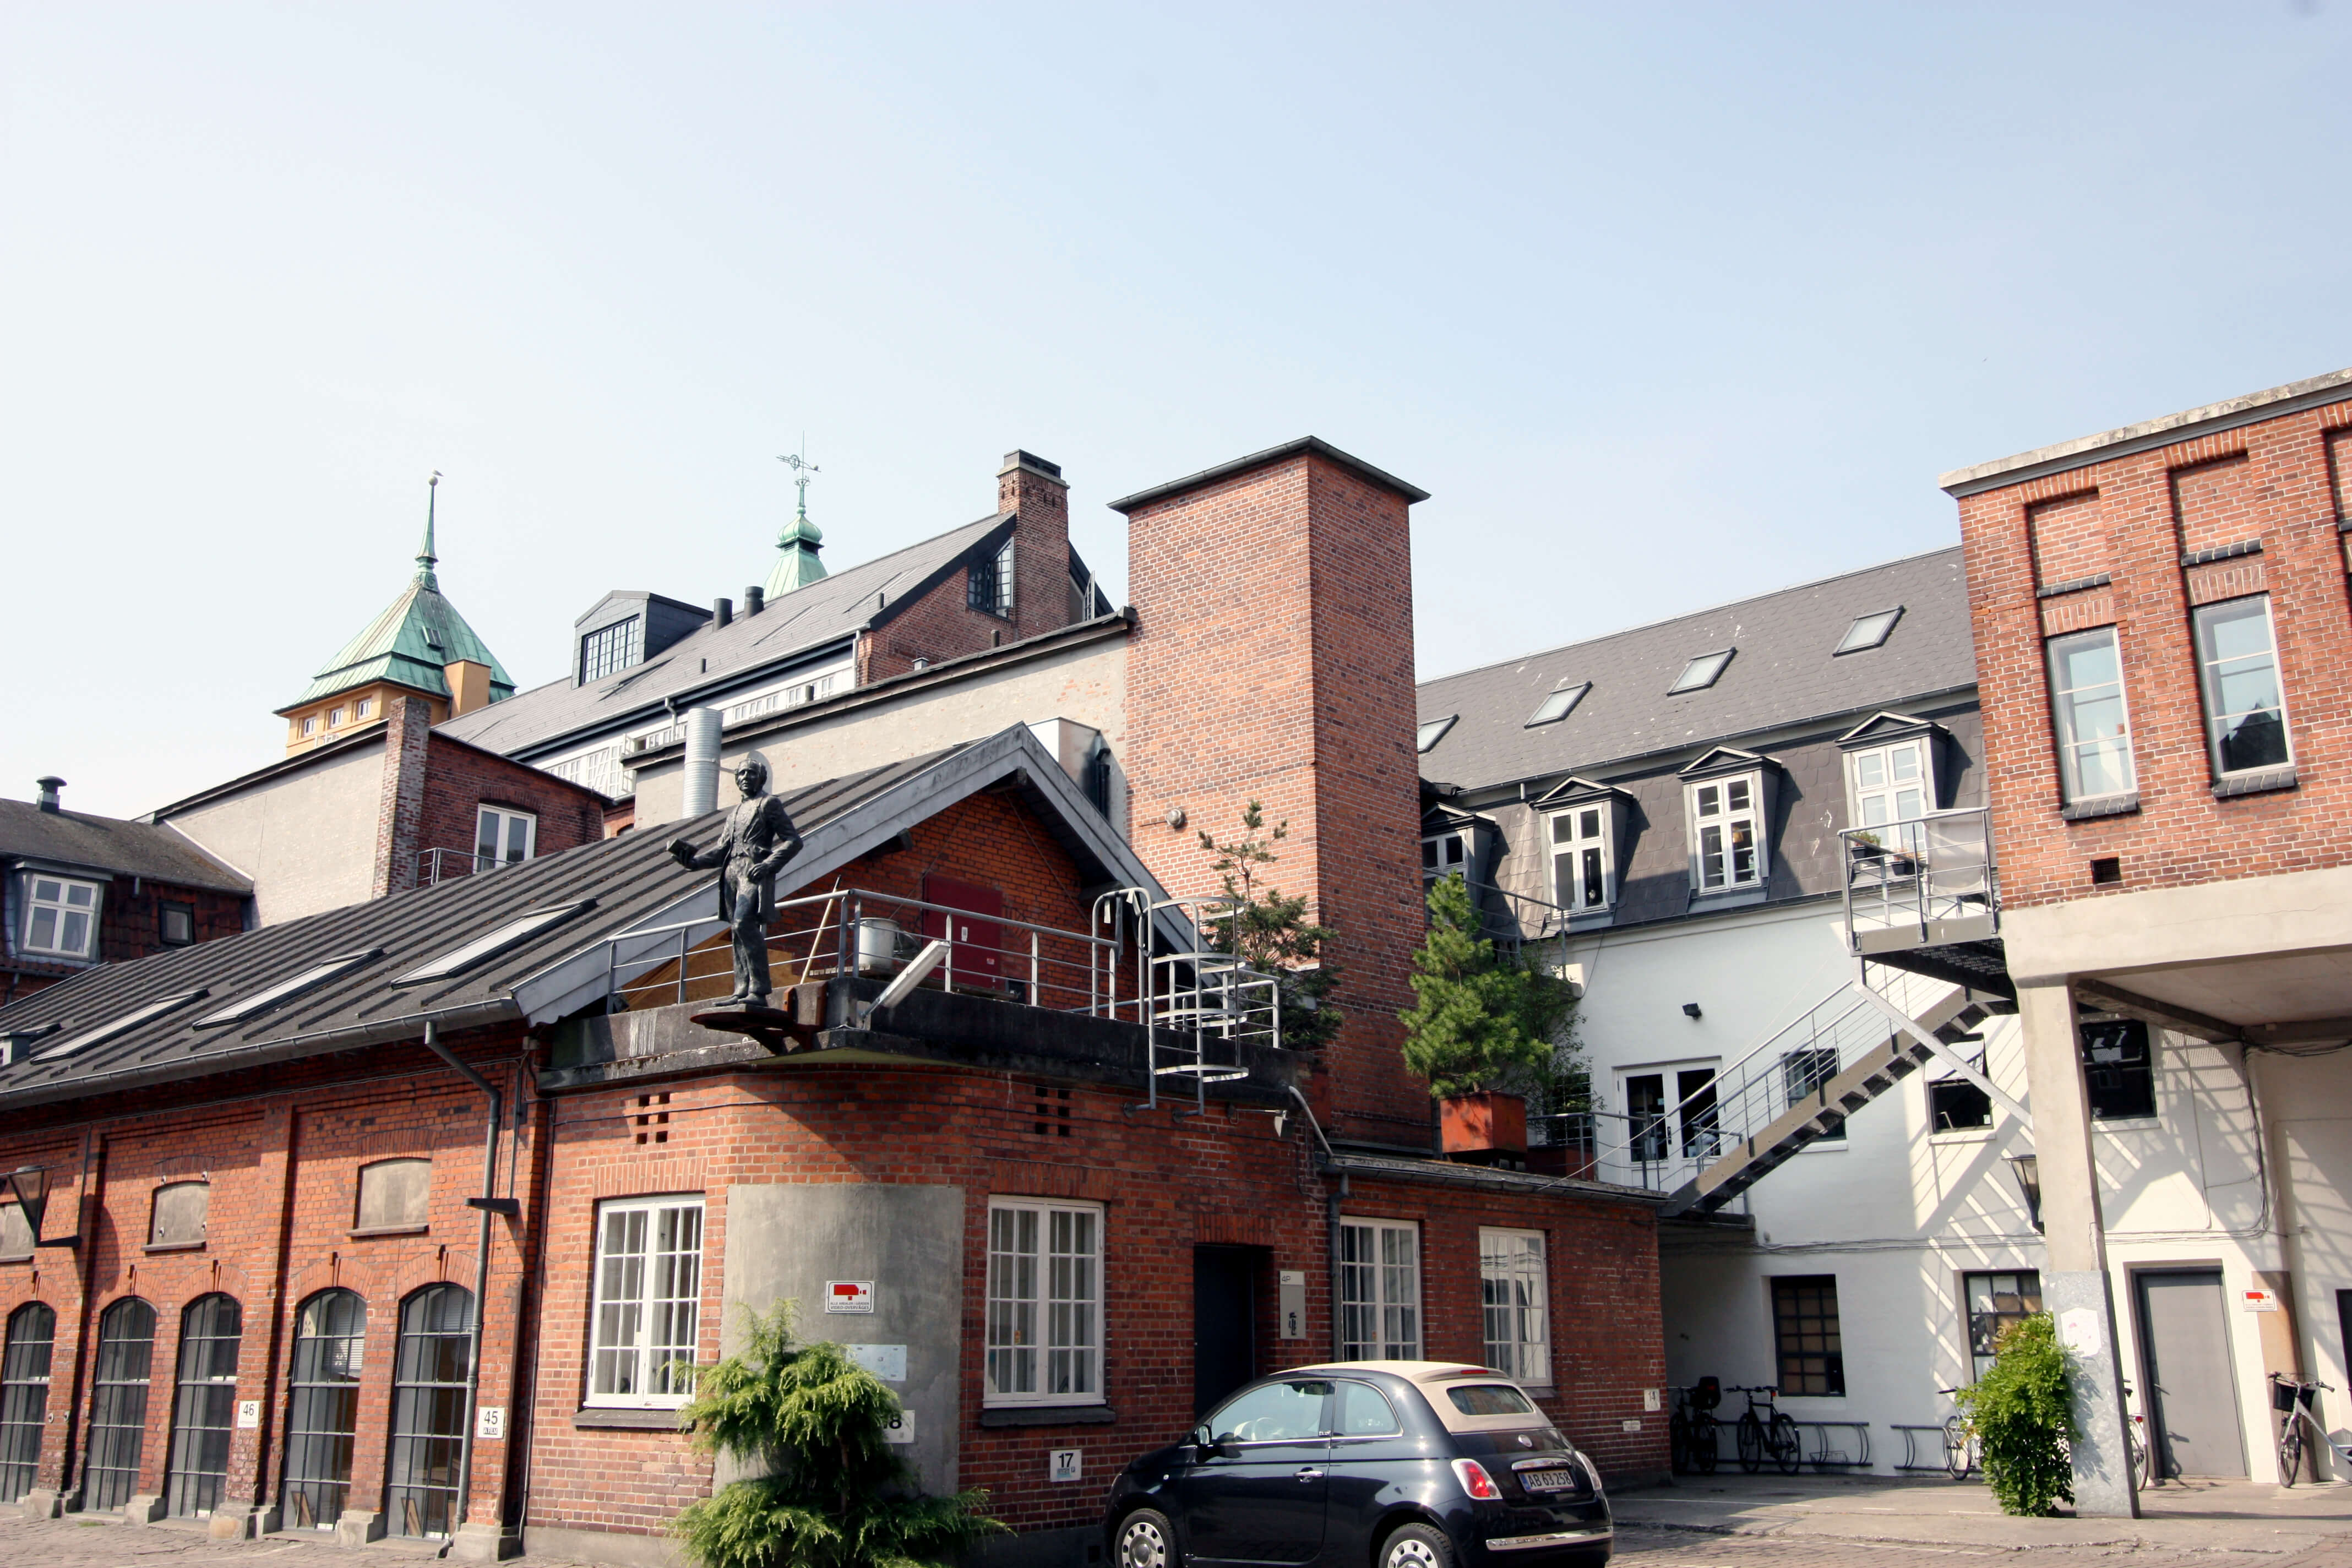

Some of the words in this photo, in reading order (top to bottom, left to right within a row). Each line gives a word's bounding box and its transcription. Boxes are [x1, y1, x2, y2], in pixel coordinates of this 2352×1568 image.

[243, 1404, 254, 1416] 46
[484, 1411, 498, 1424] 45
[1059, 1453, 1074, 1468] 17
[1528, 1474, 1542, 1487] AB
[1542, 1473, 1554, 1485] 63
[1553, 1472, 1571, 1485] 258
